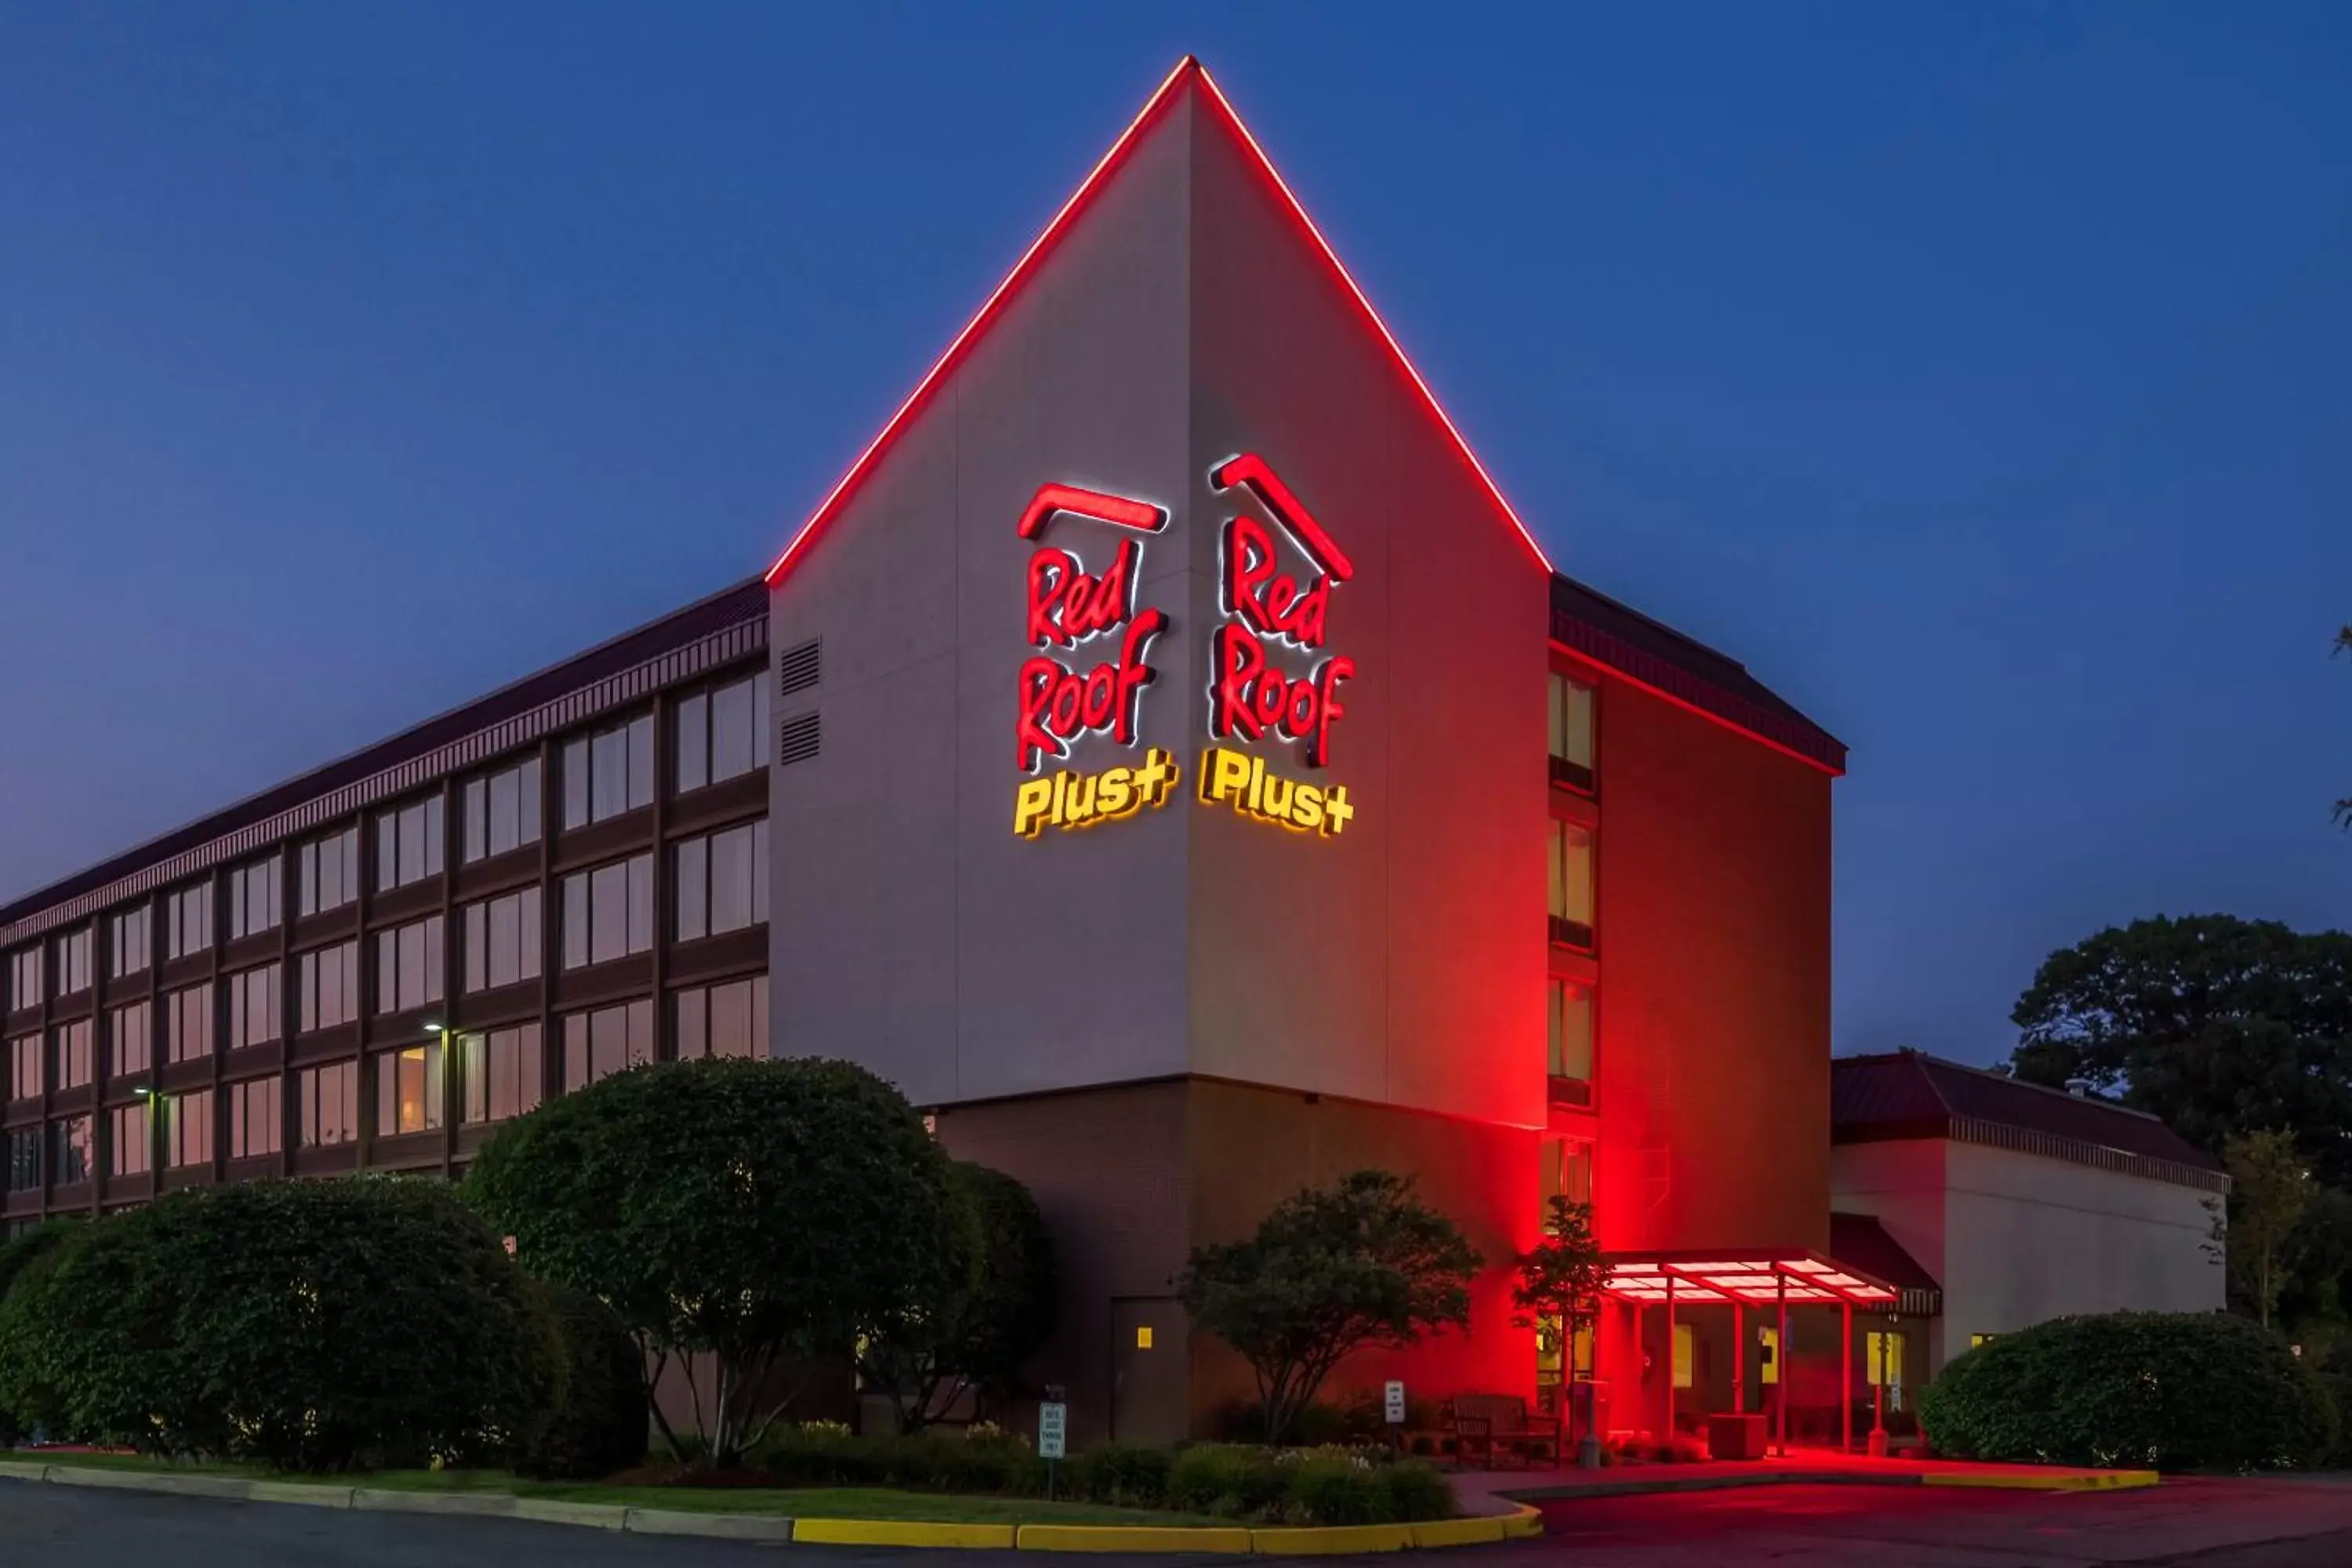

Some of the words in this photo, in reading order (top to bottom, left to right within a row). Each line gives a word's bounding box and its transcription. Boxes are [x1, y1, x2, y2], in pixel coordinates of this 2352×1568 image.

[1026, 536, 1134, 647] Red
[1231, 514, 1331, 650] Red
[1017, 607, 1165, 771] Roof
[1218, 623, 1356, 768] Roof
